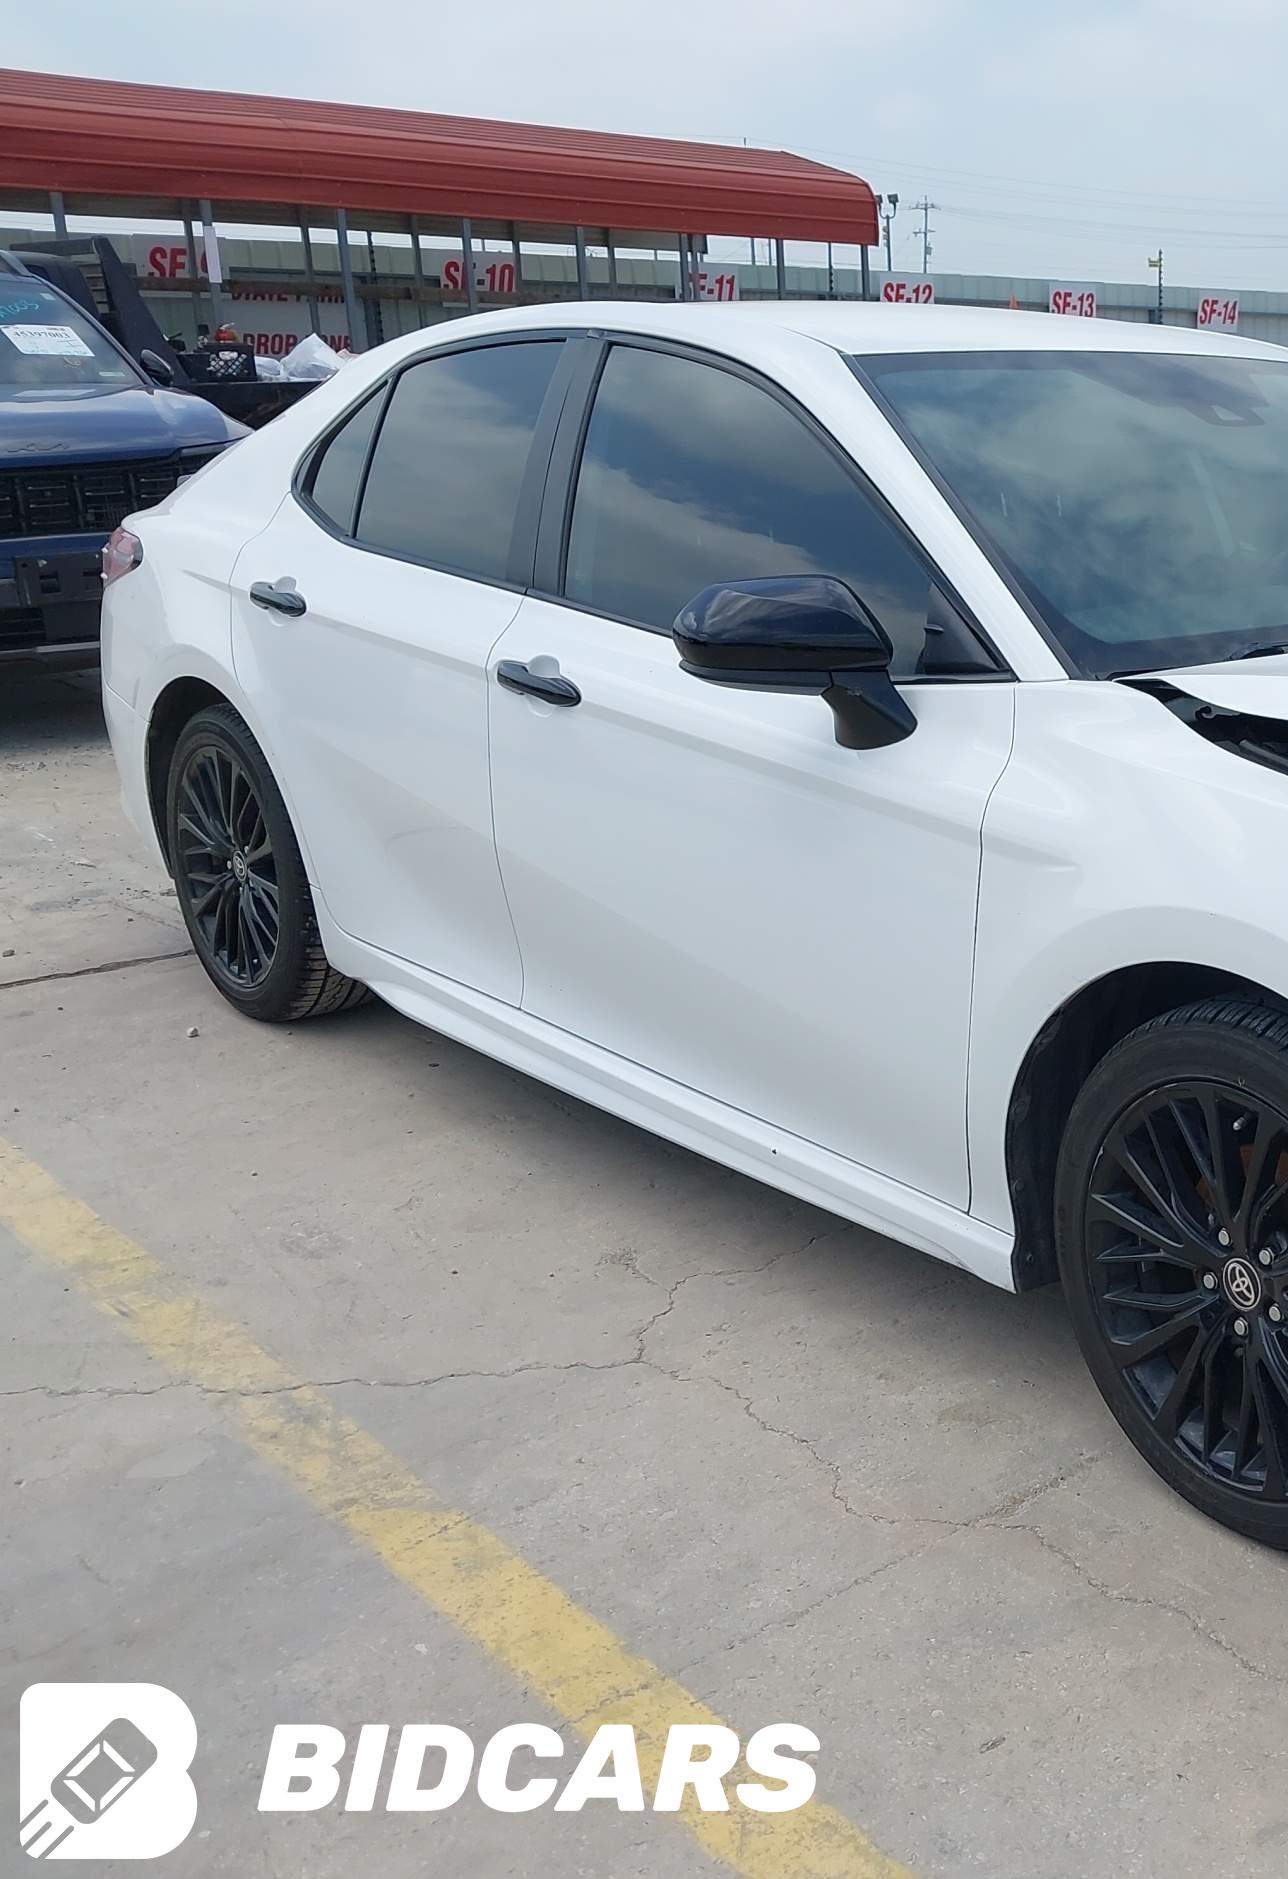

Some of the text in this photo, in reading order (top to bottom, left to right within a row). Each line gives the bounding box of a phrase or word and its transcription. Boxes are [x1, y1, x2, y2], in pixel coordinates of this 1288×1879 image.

[444, 261, 514, 292] S-10
[883, 282, 933, 304] SF-12
[1052, 291, 1095, 317] SF-13
[1199, 299, 1238, 325] SF-14
